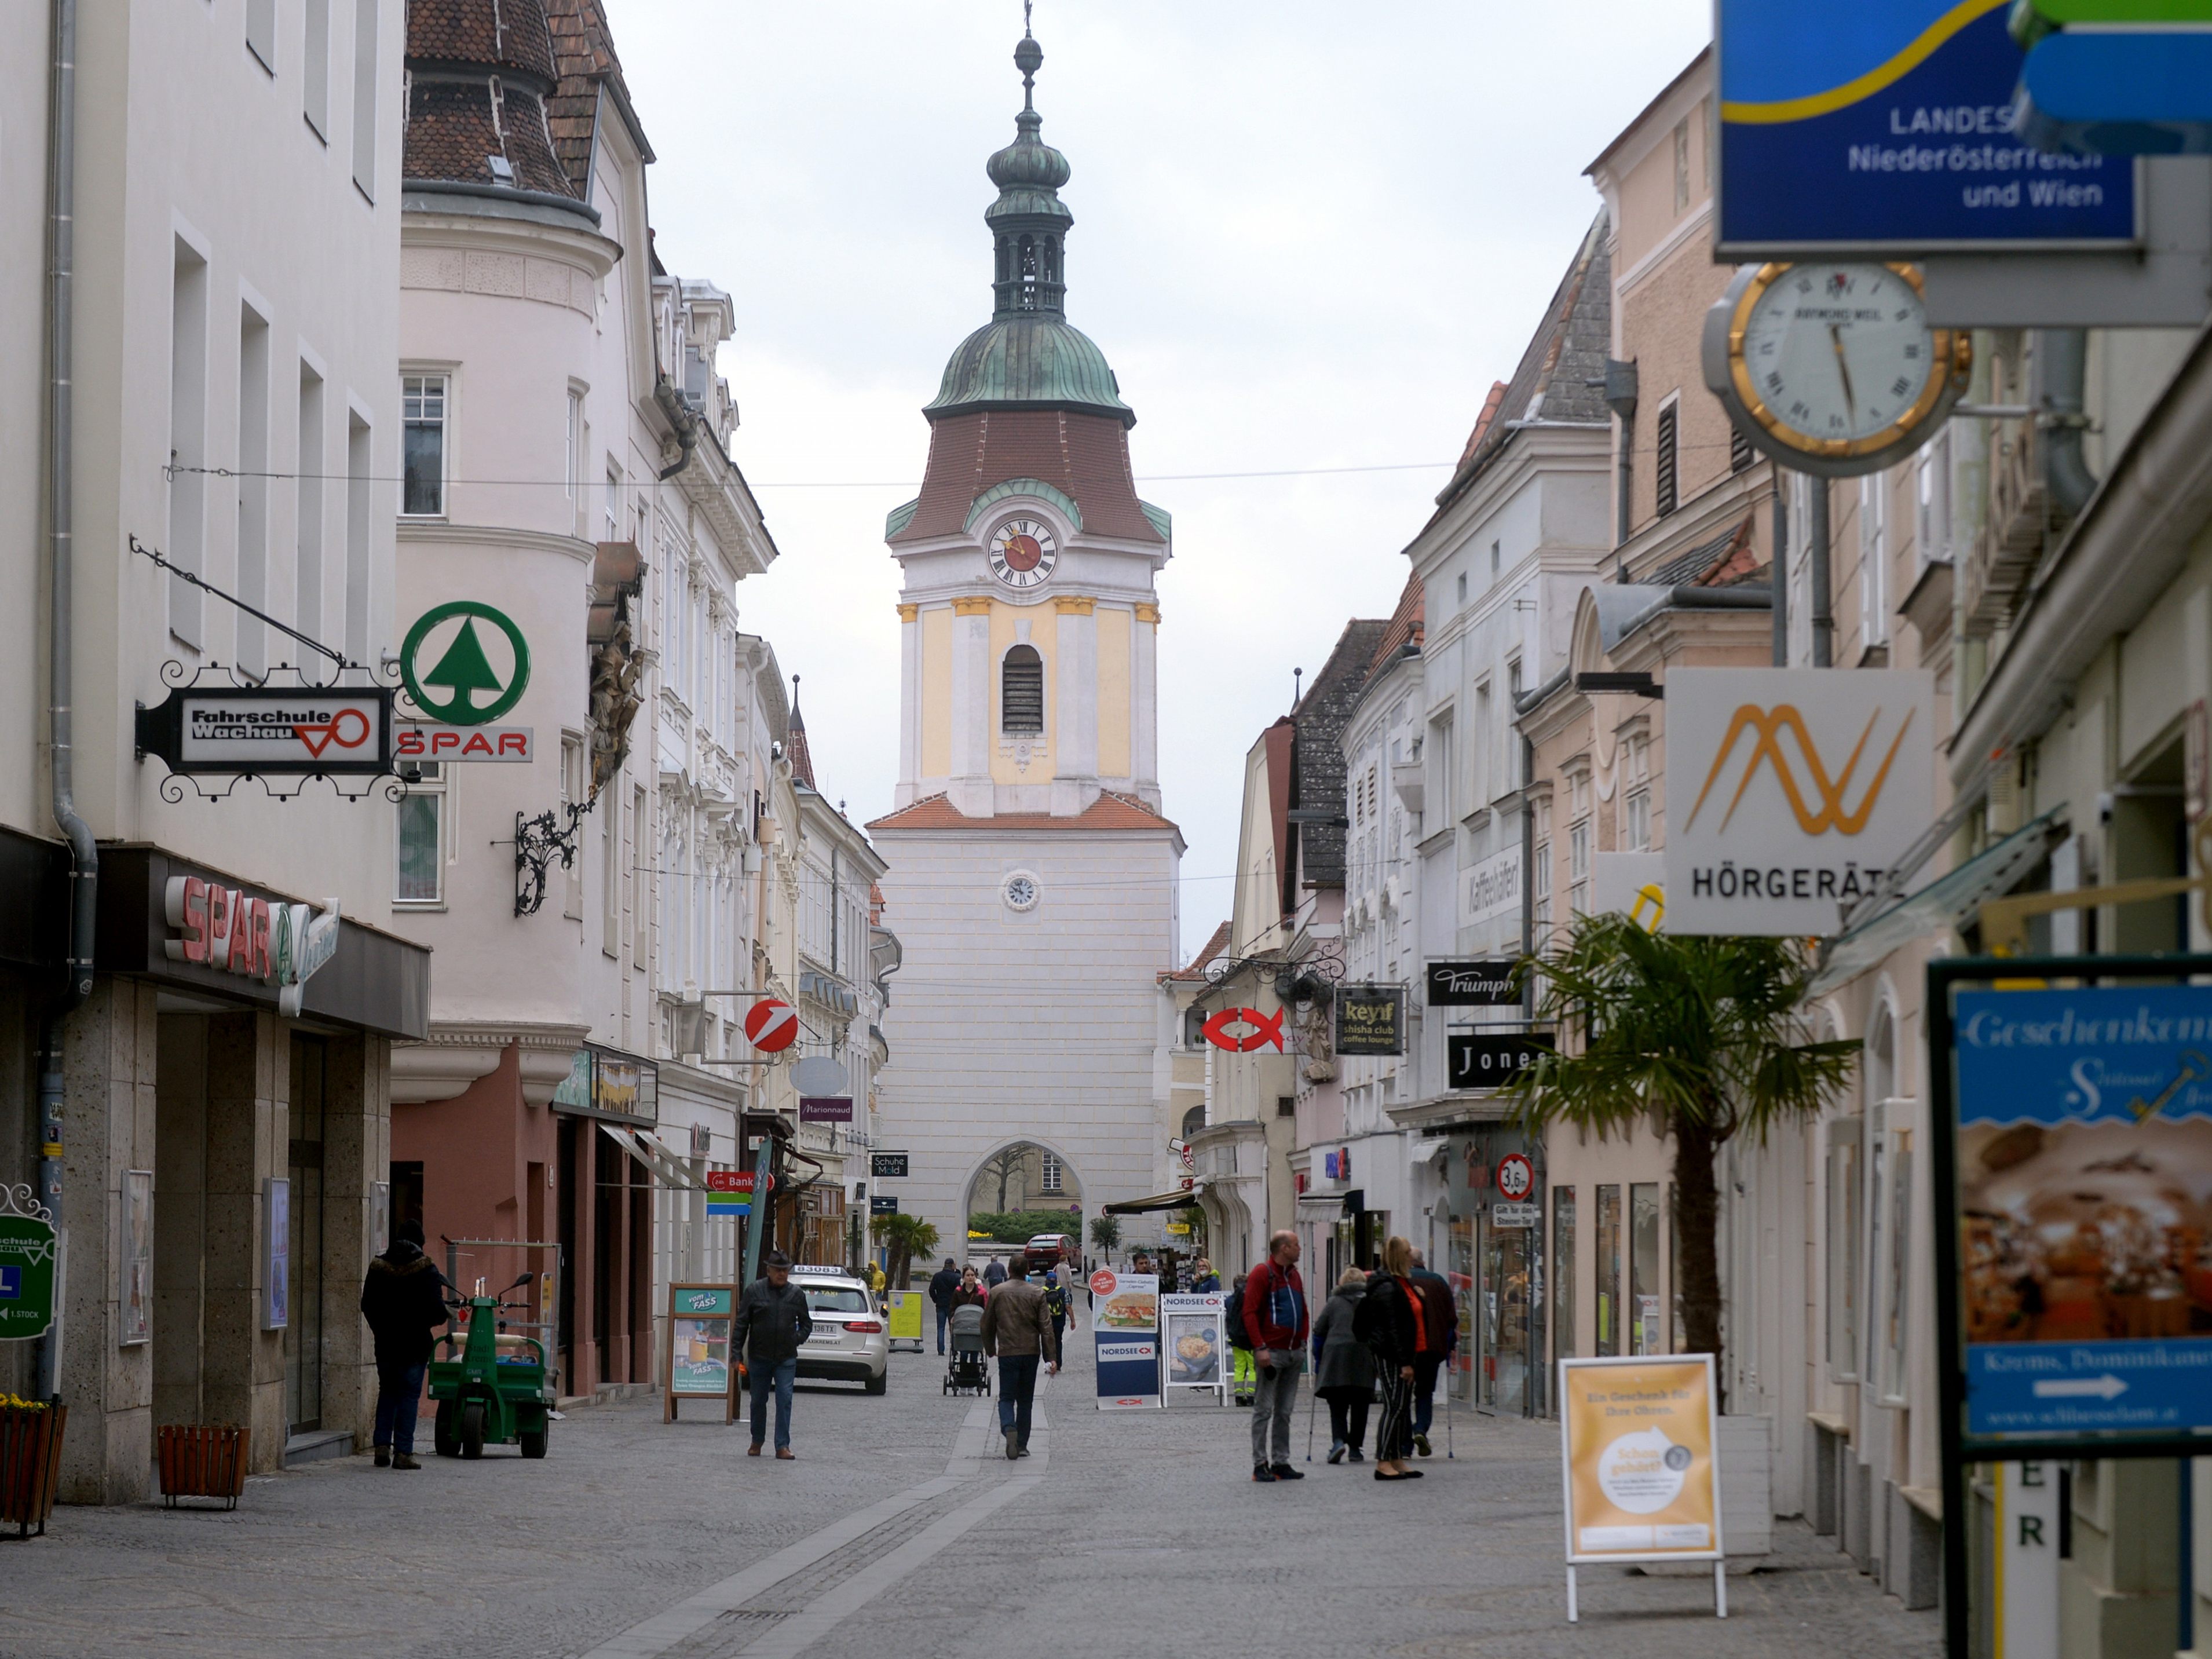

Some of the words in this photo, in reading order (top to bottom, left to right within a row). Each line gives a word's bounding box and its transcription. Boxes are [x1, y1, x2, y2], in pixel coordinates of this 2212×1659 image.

[1962, 180, 2020, 207] und
[2028, 178, 2103, 207] Wien
[192, 710, 331, 723] Fahrschule
[193, 726, 293, 739] Wachau
[398, 732, 527, 755] SPAR
[181, 875, 270, 979] SPAR
[1434, 969, 1515, 1001] Triumph
[1344, 1025, 1372, 1034] shisha
[1374, 1025, 1394, 1035] club
[1368, 1036, 1394, 1044] lounge
[802, 1104, 850, 1114] Marionnaud
[875, 1157, 904, 1165] Schuhe
[879, 1166, 900, 1174] Mold
[689, 1293, 704, 1303] vom
[693, 1297, 716, 1310] FASS
[11, 1310, 39, 1318] 1.STOCK
[693, 1365, 712, 1375] FASS
[1587, 1393, 1607, 1402] Ein
[1610, 1391, 1668, 1402] Geschenk
